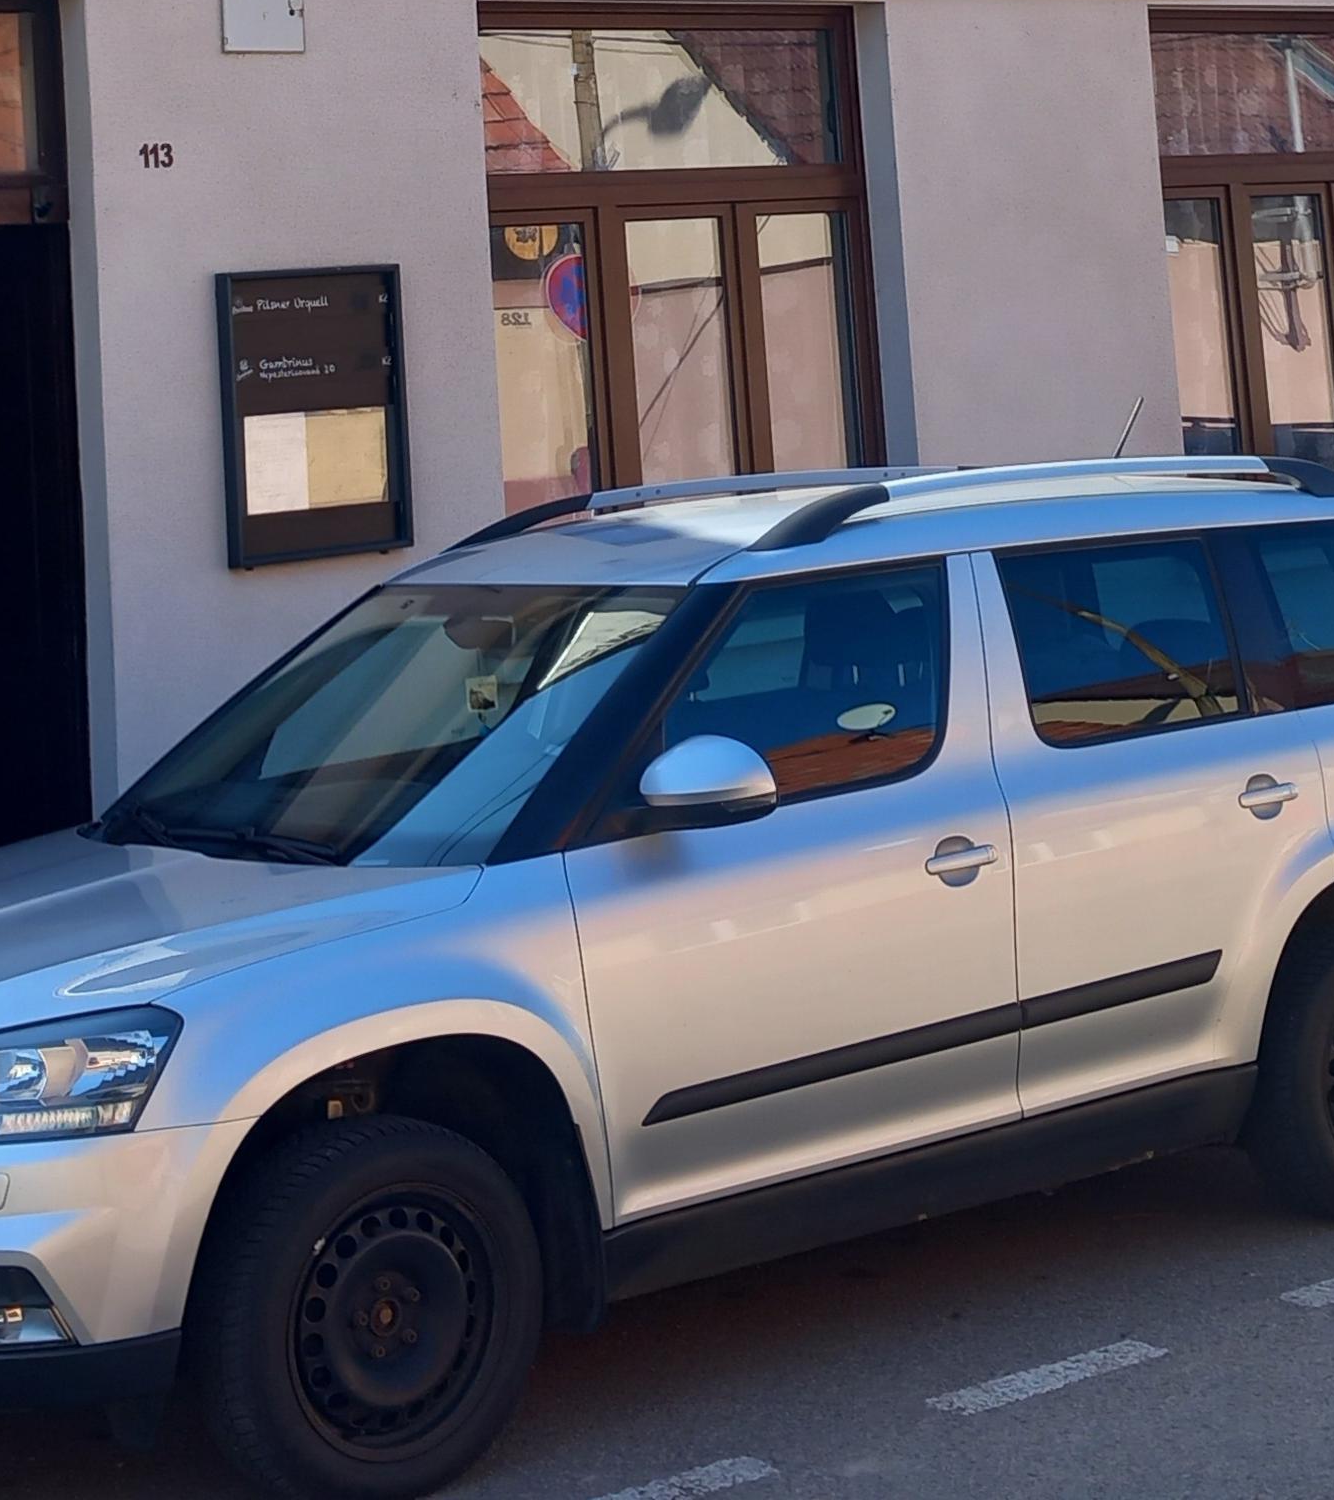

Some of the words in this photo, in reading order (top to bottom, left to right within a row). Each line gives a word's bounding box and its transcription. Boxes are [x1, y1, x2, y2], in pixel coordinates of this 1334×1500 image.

[139, 143, 174, 168] 113
[255, 298, 291, 312] Pilsner
[293, 295, 329, 313] Urquell
[259, 355, 313, 370] Gambrinus
